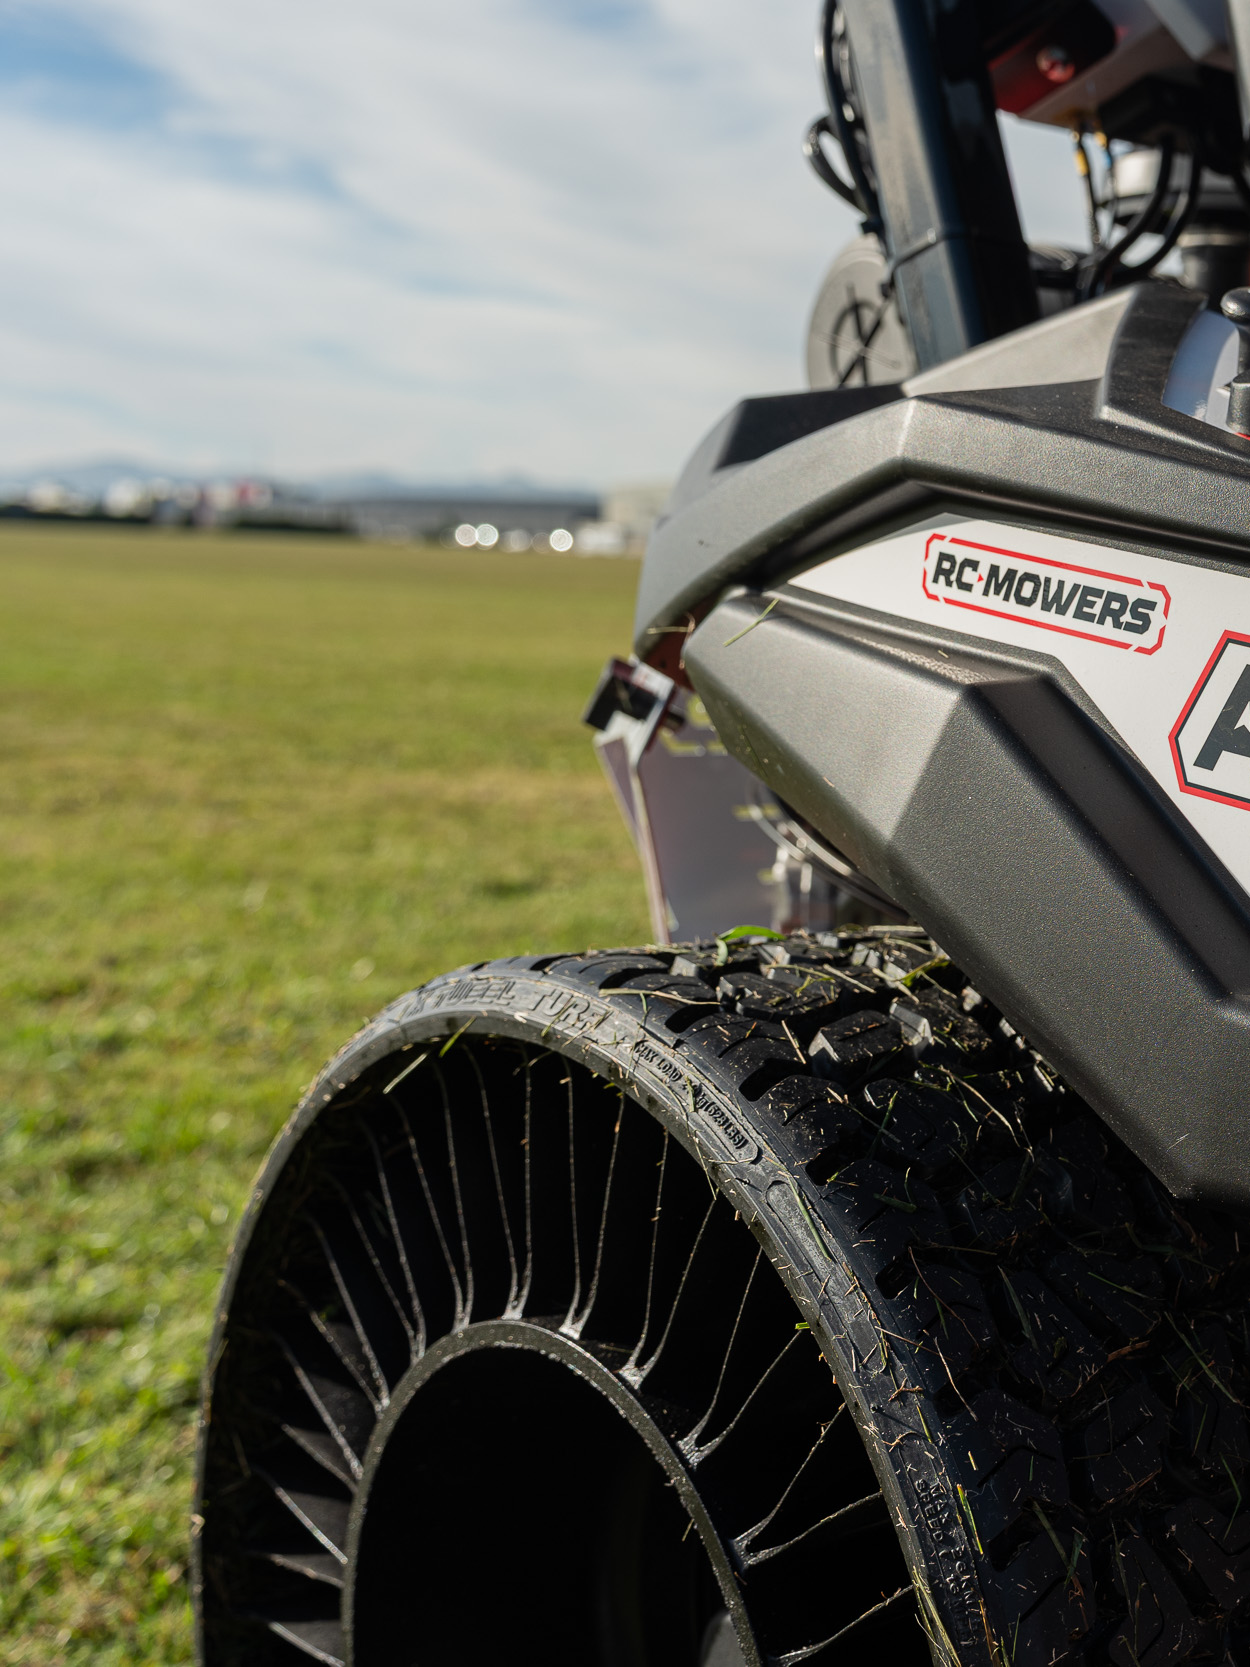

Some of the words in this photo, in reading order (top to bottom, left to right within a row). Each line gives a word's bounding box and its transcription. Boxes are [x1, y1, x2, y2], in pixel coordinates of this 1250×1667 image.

[634, 1043, 659, 1063] MAX
[657, 1058, 683, 1082] LOAD
[914, 1478, 944, 1543] SPEED
